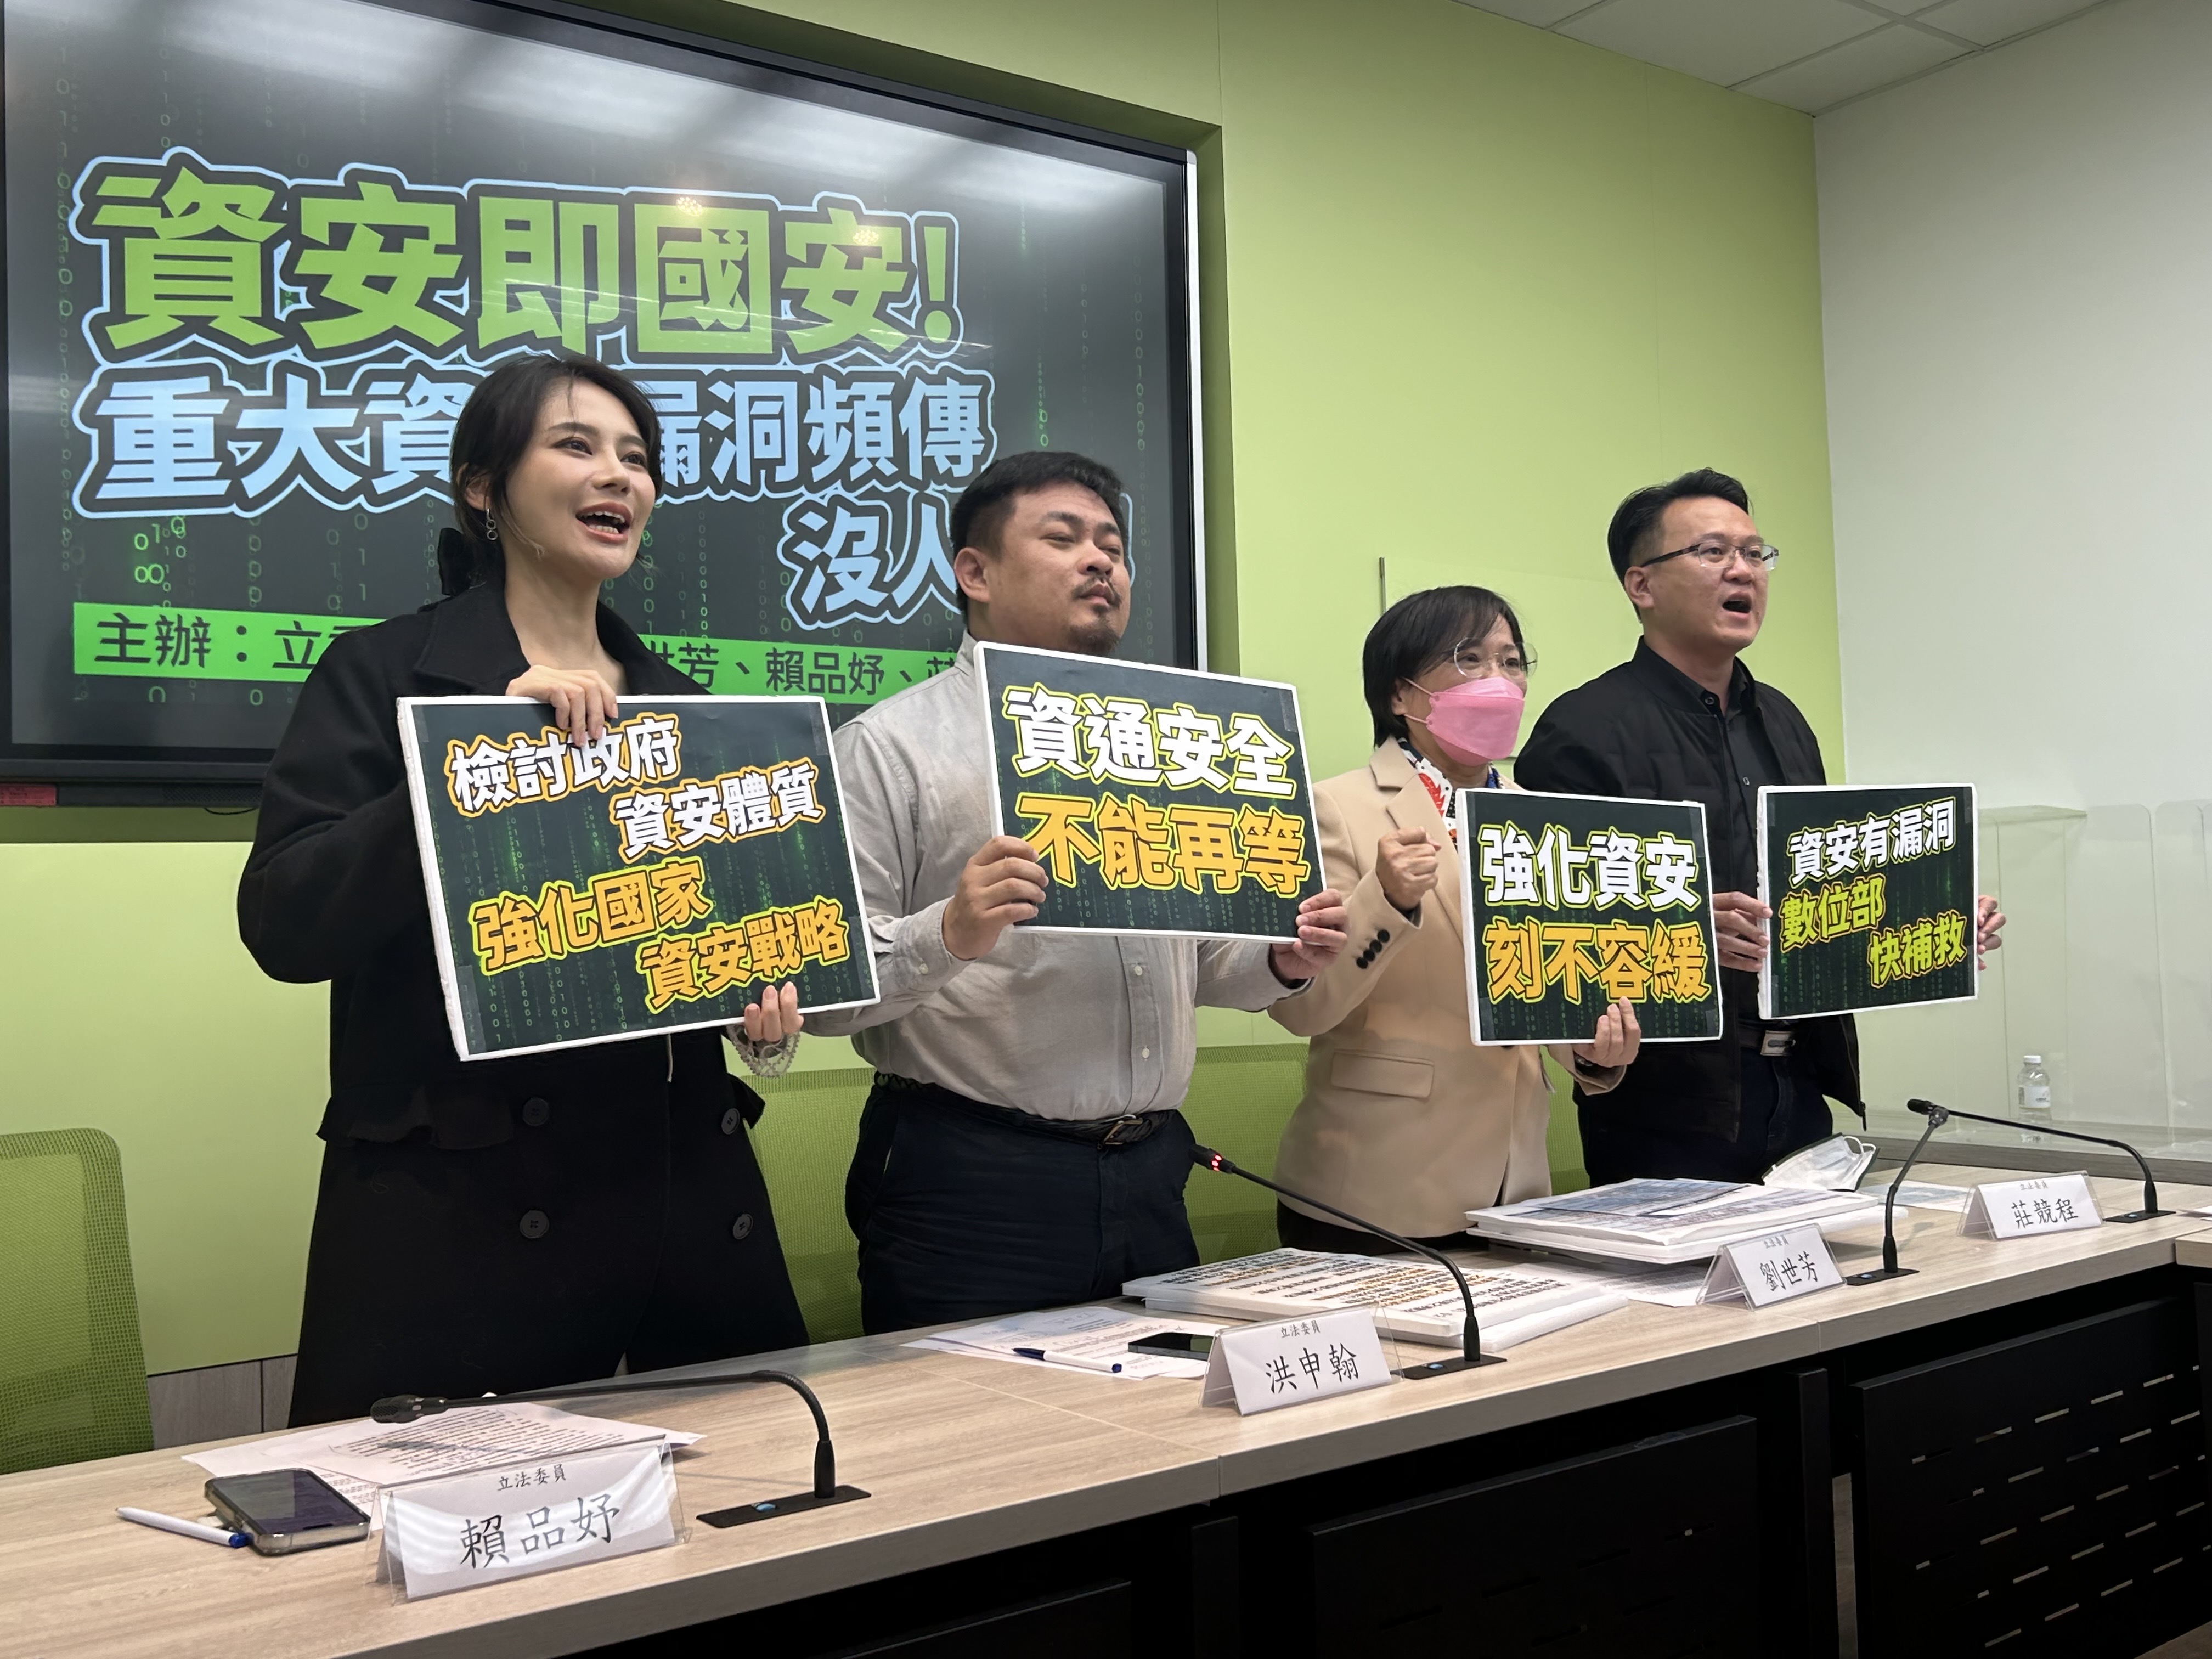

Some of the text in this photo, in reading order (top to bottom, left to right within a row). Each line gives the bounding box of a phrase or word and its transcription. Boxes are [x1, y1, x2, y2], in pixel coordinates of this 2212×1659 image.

[452, 717, 678, 811] 檢討政府
[1006, 687, 1293, 795] 資通安全
[616, 764, 821, 857] 資安體質
[1019, 795, 1307, 895] 不能再等
[1790, 800, 1954, 884] 資安有漏洞
[1481, 826, 1699, 909] 強化資安
[475, 861, 709, 969] 強化國家
[642, 902, 847, 1007] 資安戰略
[1781, 877, 1883, 949] 數位部
[1870, 913, 1966, 985] 快補救
[1485, 919, 1710, 1003] 刻不容緩
[2011, 1198, 2079, 1228] 莊競程
[1760, 1251, 1818, 1291] 劉世芳
[1266, 1342, 1359, 1393] 洪申翰
[1281, 1319, 1321, 1338] 立法委員
[497, 1464, 566, 1491] 立法委員
[460, 1493, 620, 1569] 賴品妤
